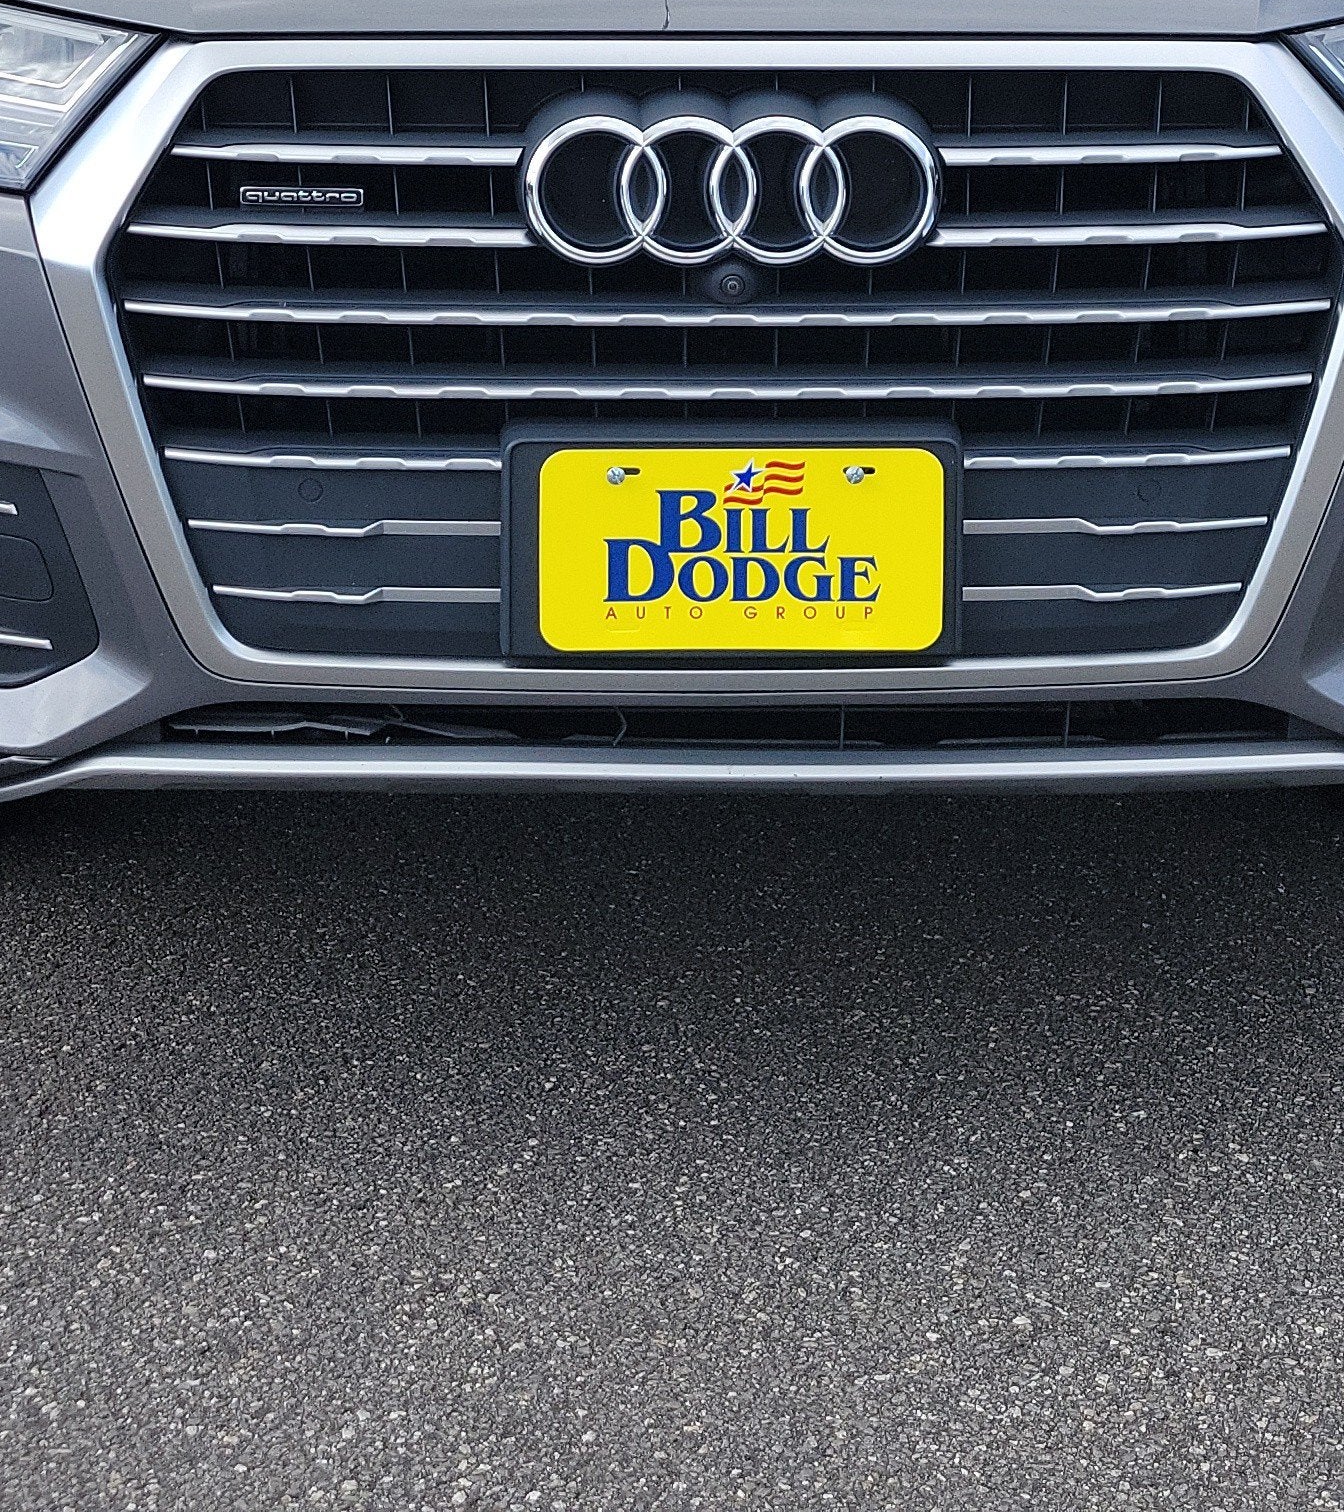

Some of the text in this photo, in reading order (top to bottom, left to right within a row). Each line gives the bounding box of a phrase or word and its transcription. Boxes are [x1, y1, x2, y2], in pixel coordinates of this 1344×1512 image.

[245, 190, 358, 203] quattro
[655, 489, 830, 554] BILL
[603, 538, 882, 603] DODGE
[605, 605, 875, 621] AUTO GROUP
